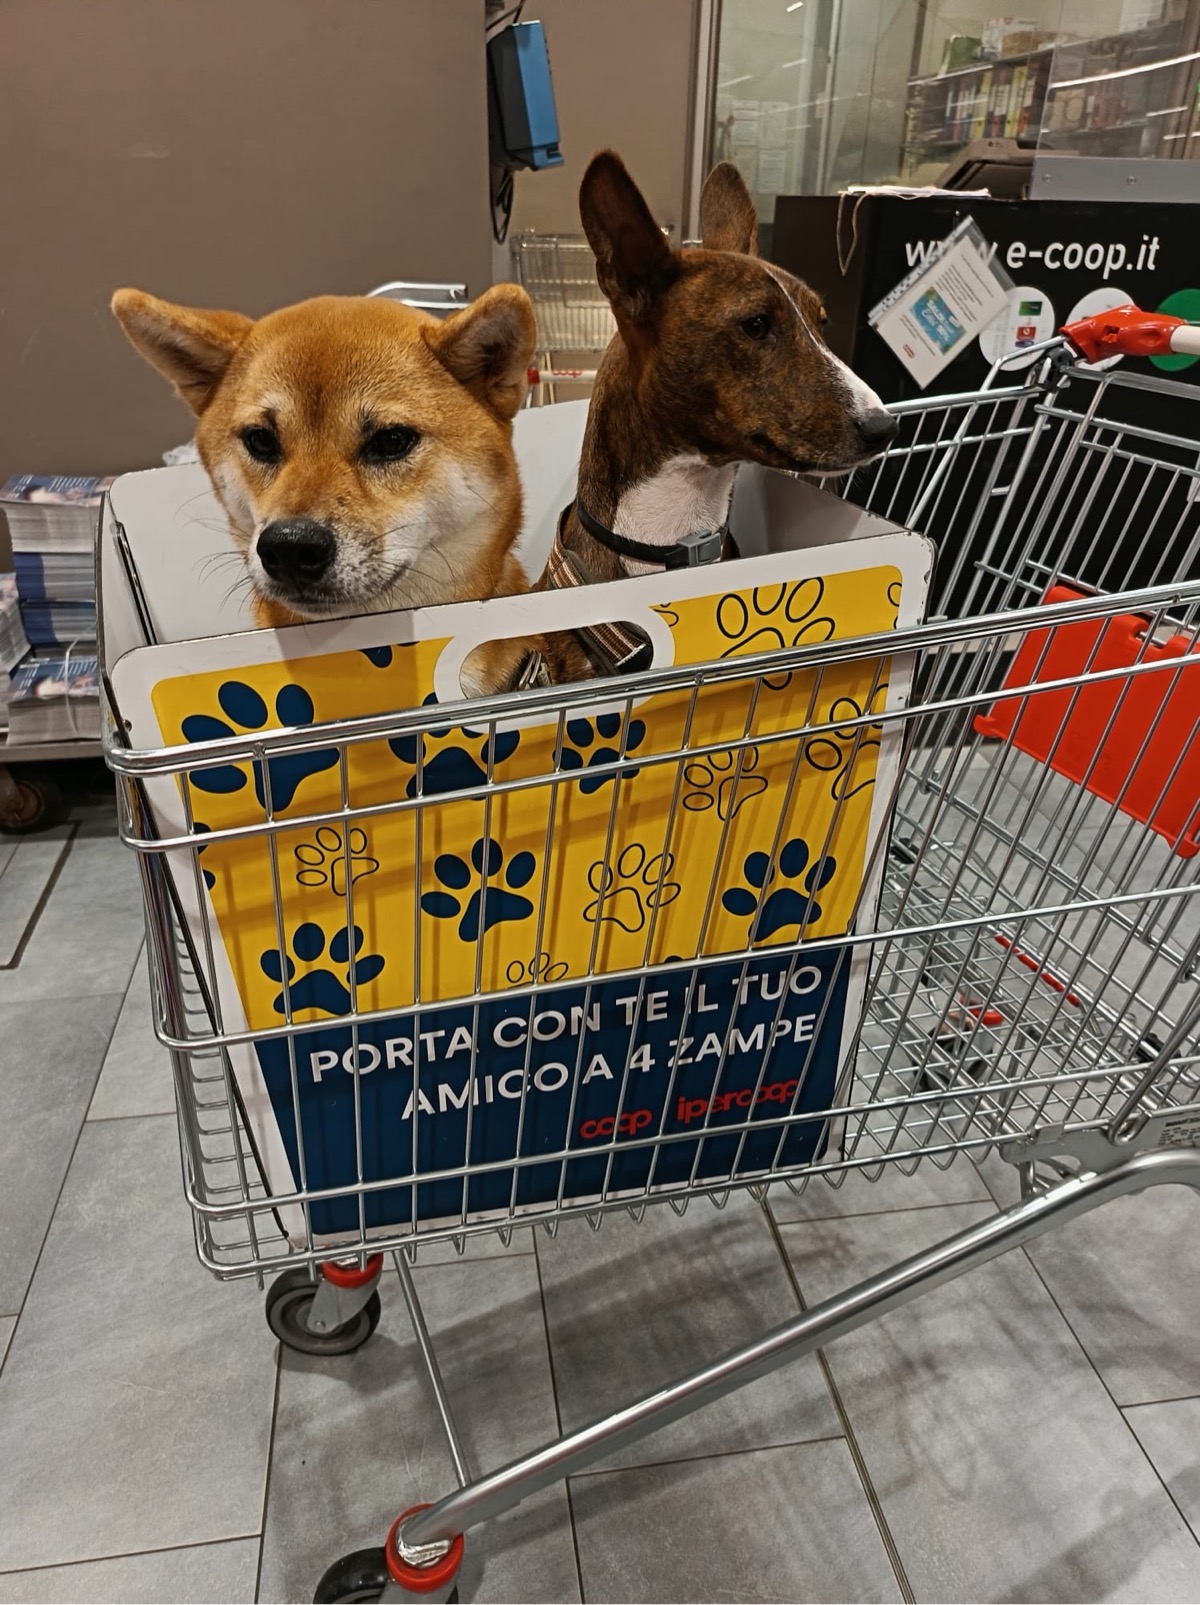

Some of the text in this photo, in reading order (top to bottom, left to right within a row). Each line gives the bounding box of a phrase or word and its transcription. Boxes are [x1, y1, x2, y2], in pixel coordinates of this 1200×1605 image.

[309, 965, 822, 1083] PORTA CON TE IL TUO
[401, 1013, 816, 1120] AMICO A 4 ZAMPE
[579, 1078, 801, 1139] coop ipercoop
